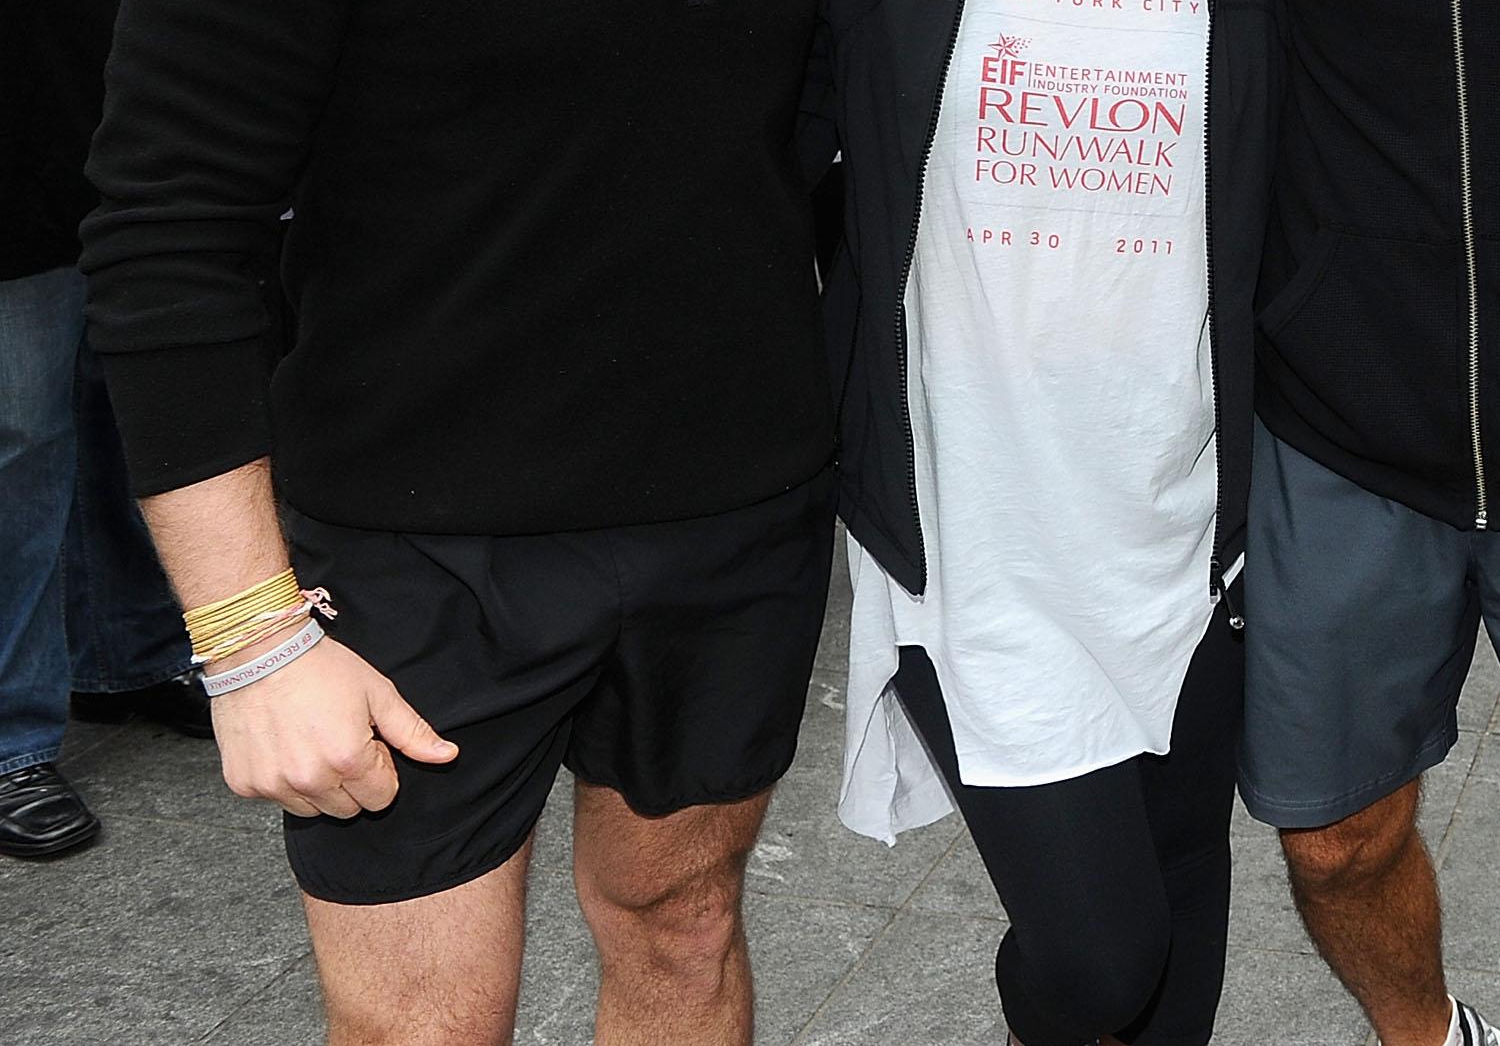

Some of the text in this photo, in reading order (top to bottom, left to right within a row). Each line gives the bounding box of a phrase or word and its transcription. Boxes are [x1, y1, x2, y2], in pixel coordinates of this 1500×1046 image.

[981, 56, 1027, 87] EIF
[1034, 63, 1188, 86] ENTERTAINMENT
[1033, 79, 1188, 100] INDUSTRY FOUNDATION
[978, 87, 1186, 136] REVLON
[976, 126, 1178, 168] RUN/WALK
[975, 159, 1173, 196] FOR WOMEN
[966, 227, 1174, 255] APR 30 2011
